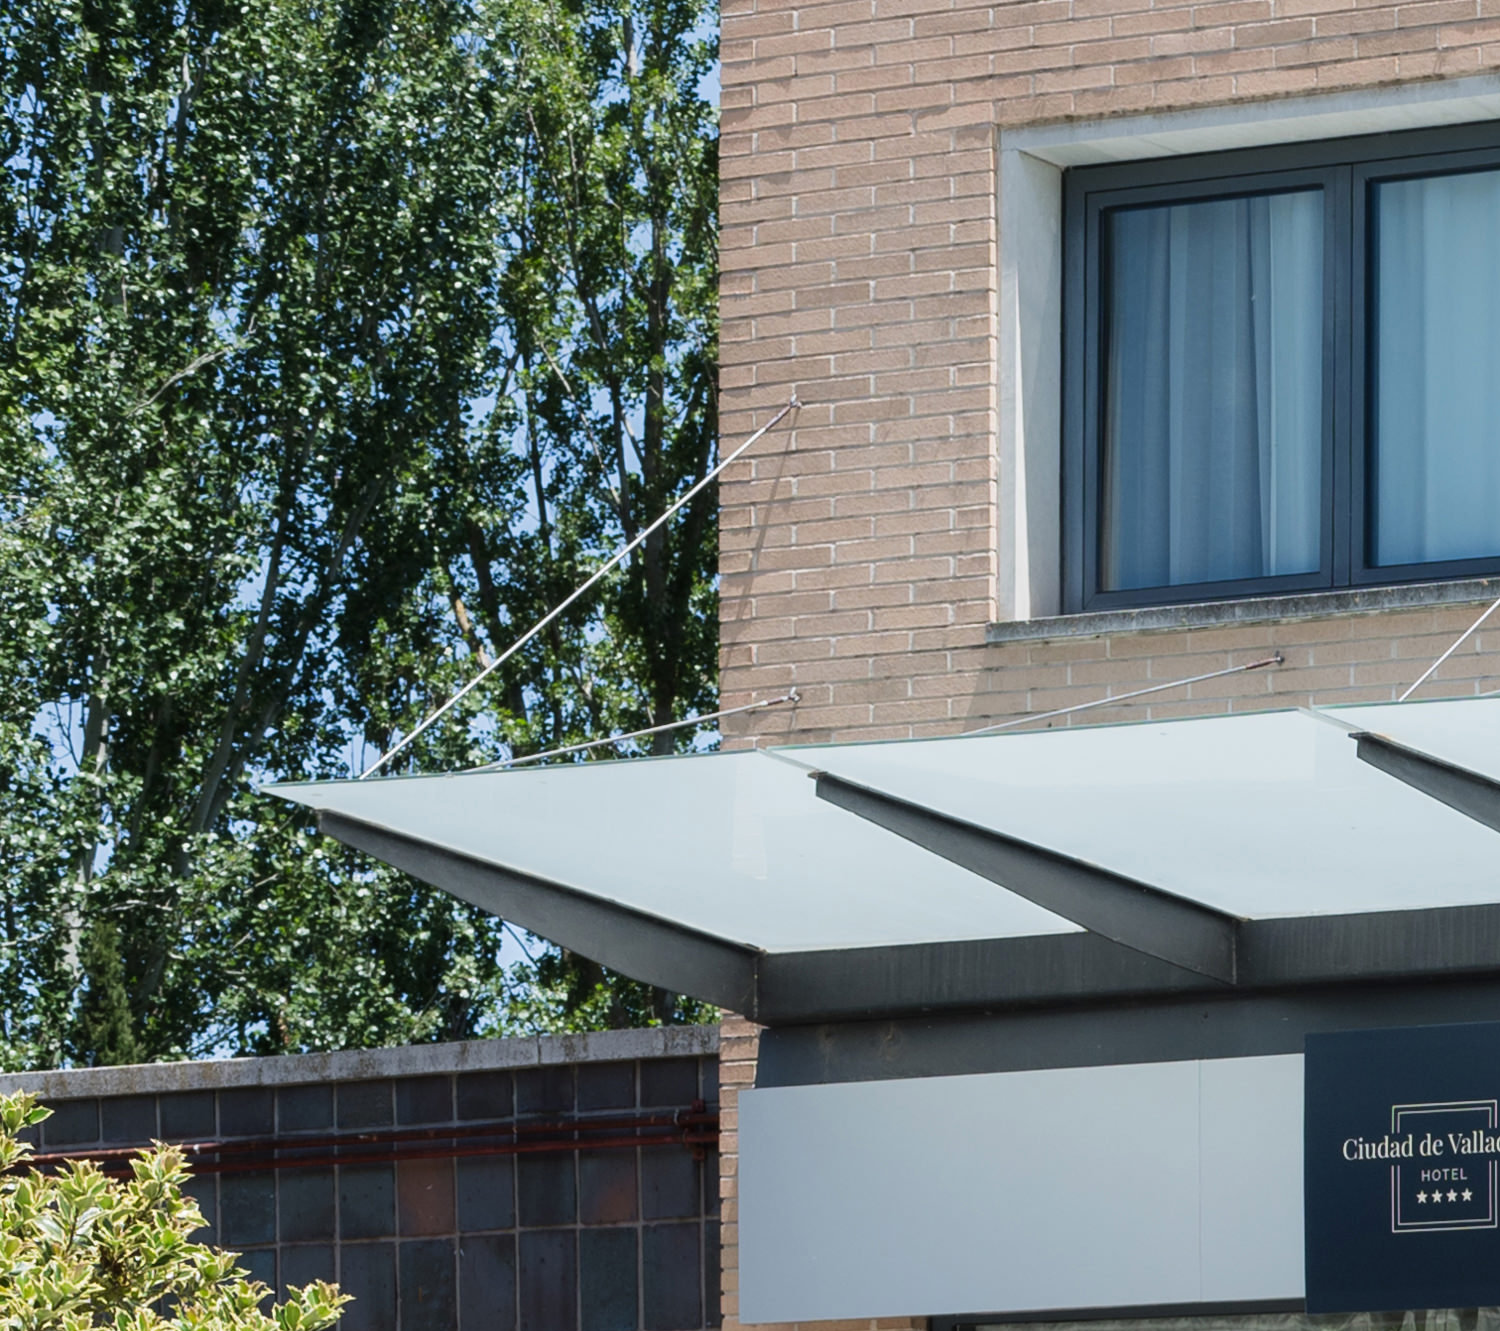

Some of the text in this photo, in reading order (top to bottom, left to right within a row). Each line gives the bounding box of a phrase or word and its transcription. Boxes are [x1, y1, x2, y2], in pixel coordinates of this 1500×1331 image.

[1342, 1133, 1414, 1161] Ciudad
[1419, 1132, 1444, 1157] de
[1420, 1167, 1468, 1182] HOTEL
